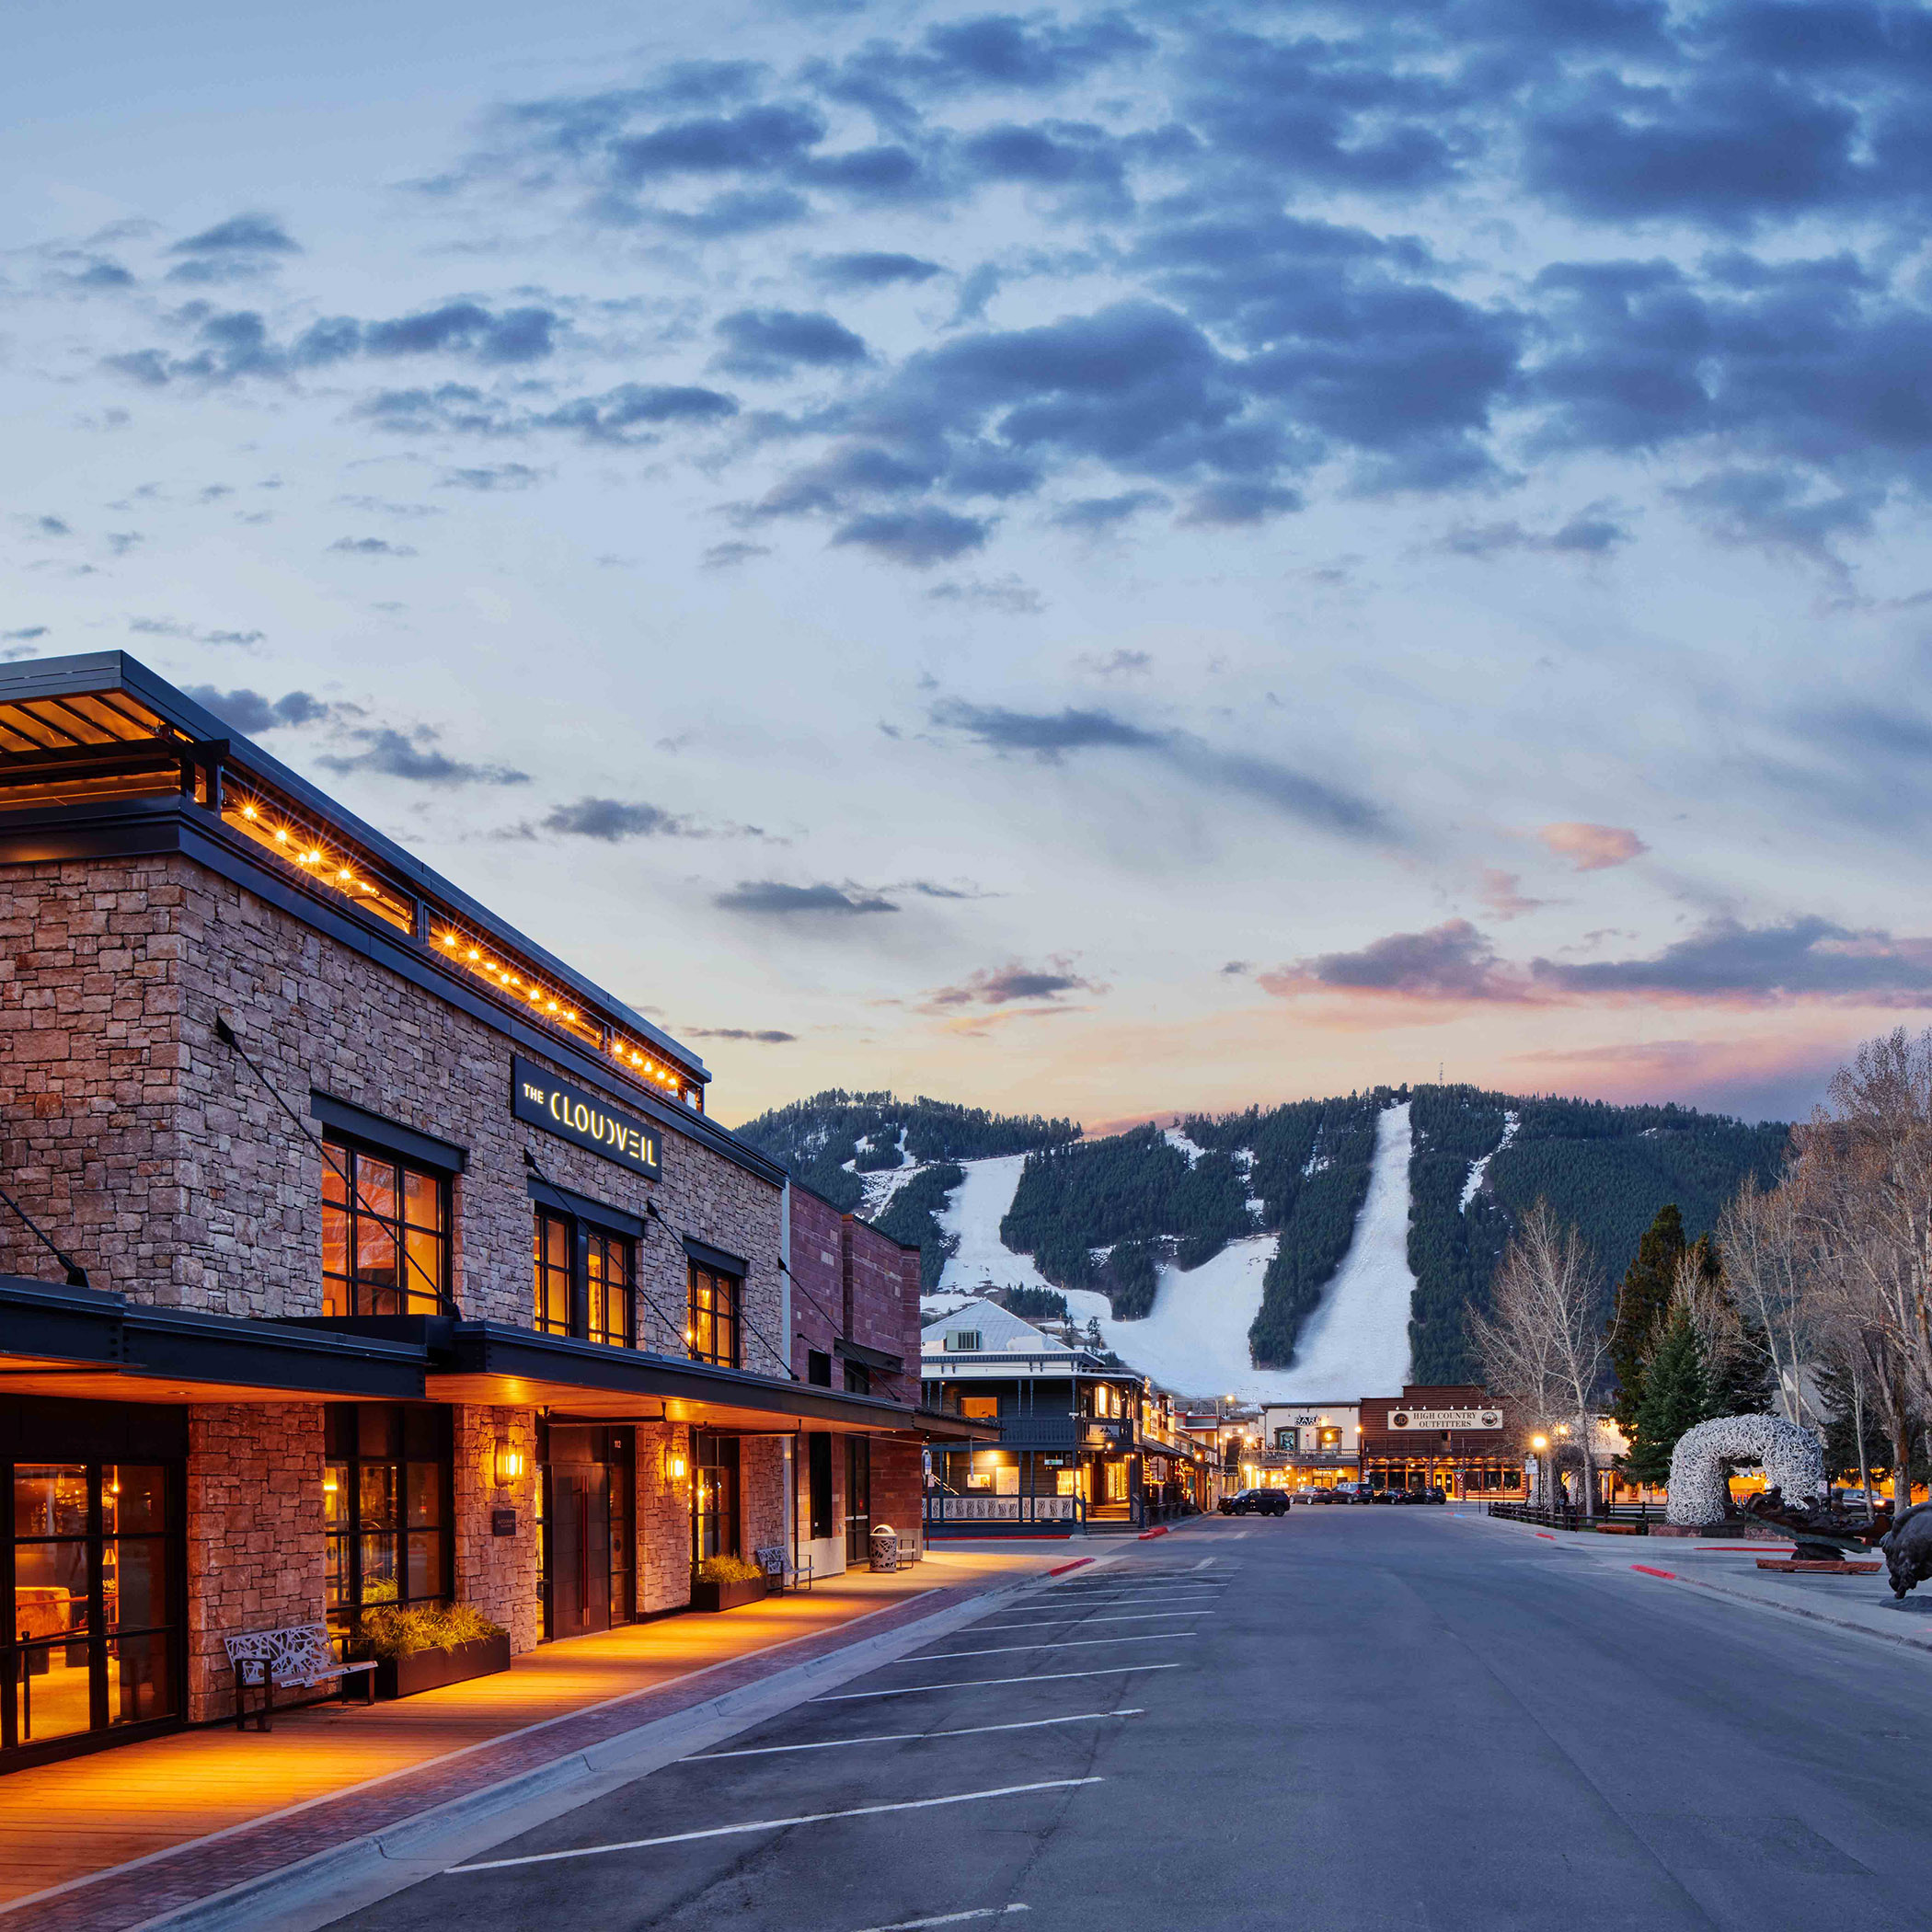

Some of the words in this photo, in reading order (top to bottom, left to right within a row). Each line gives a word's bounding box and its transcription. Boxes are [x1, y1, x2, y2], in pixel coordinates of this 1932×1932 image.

[523, 1083, 544, 1104] THE
[550, 1092, 657, 1167] CLOUDVEIL
[1437, 1411, 1478, 1420] COUNTRY
